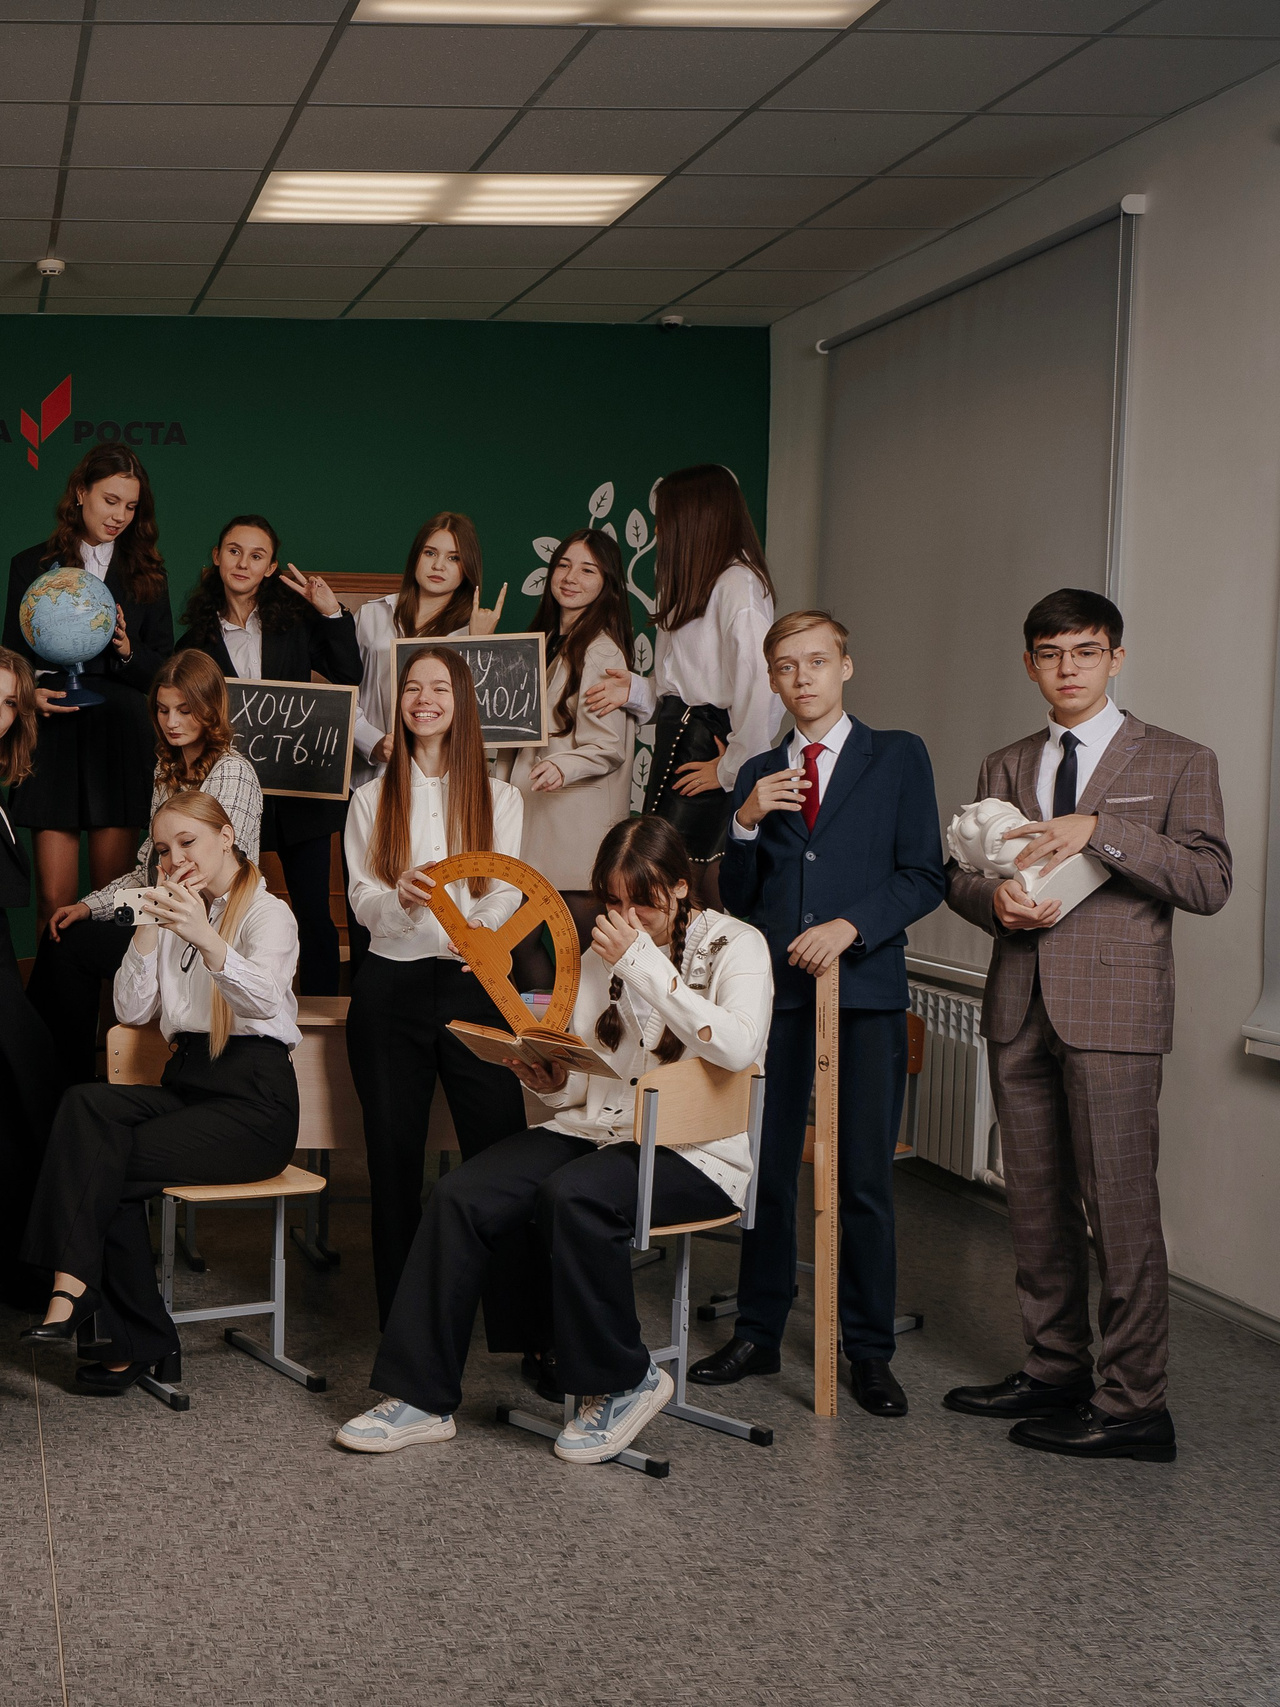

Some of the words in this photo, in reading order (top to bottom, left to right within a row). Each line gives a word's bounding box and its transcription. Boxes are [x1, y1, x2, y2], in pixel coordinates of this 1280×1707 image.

[73, 420, 188, 446] РОСТА
[230, 689, 317, 729] ХОЧУ
[474, 667, 538, 726] МОЙ!
